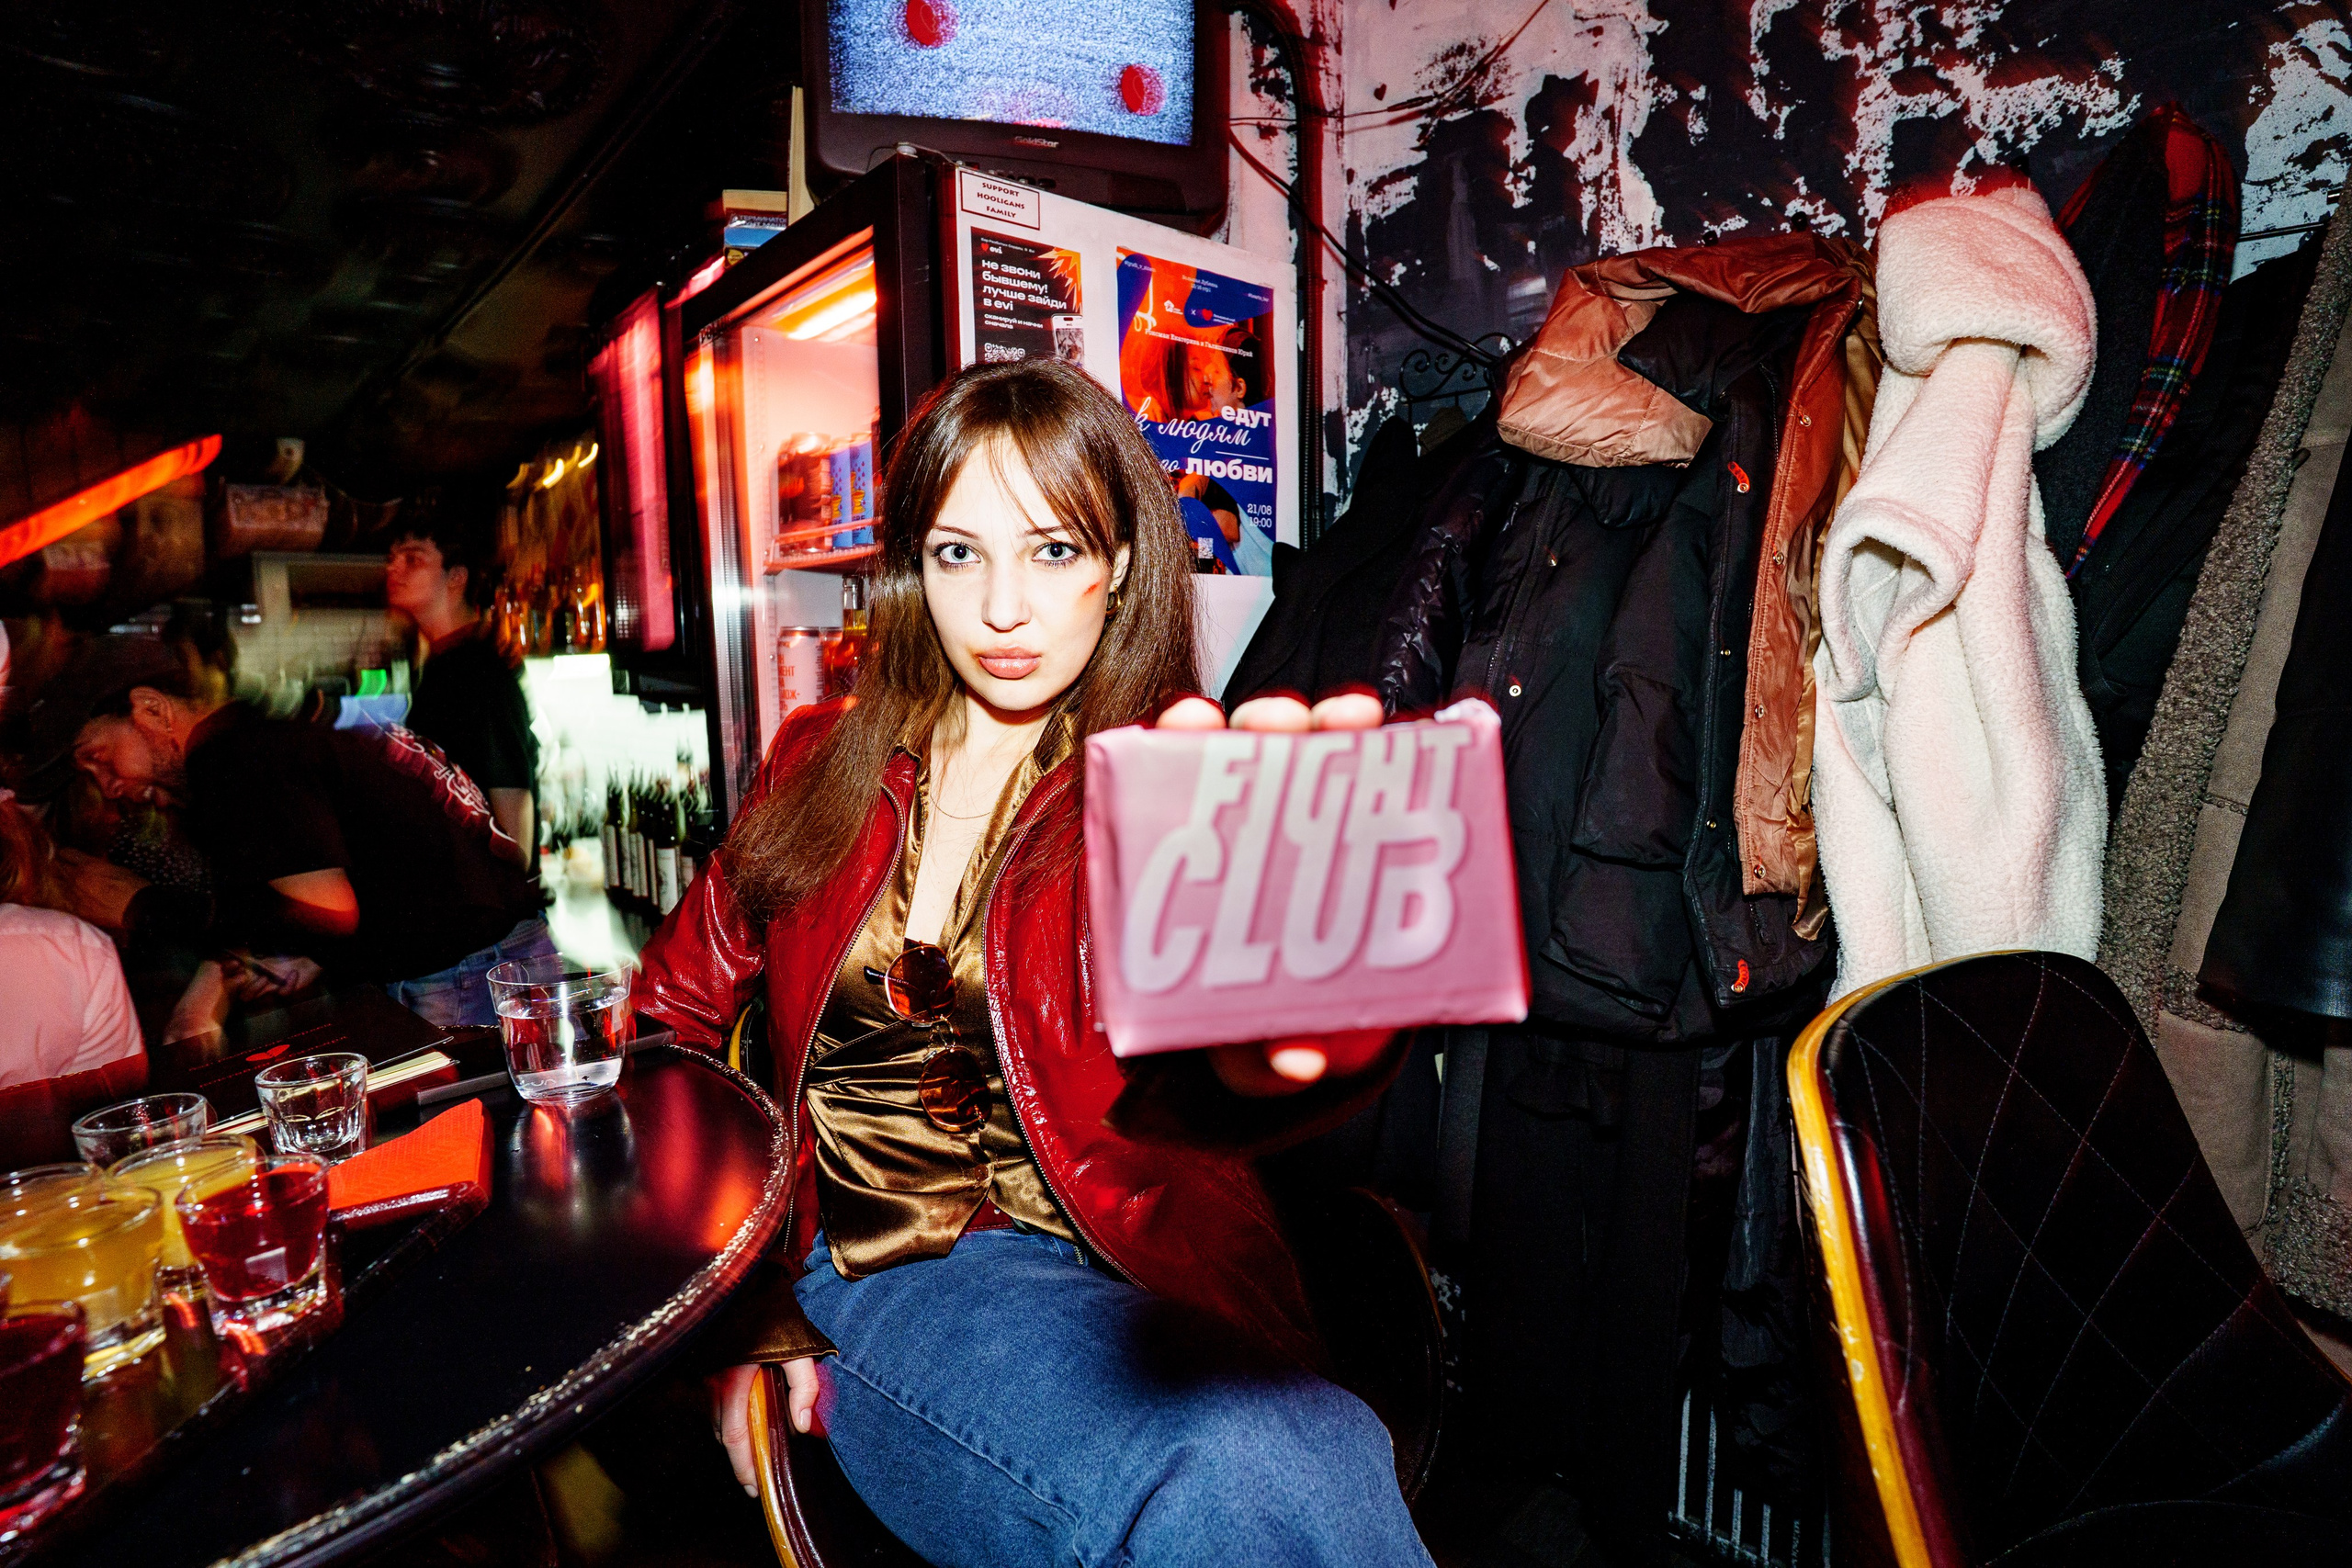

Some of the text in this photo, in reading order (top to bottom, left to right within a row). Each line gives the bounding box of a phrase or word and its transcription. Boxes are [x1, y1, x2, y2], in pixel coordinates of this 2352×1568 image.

[1014, 136, 1058, 148] GoldStar
[982, 182, 1019, 197] SUPPORT
[977, 192, 1024, 209] HOOLIGANS
[986, 206, 1016, 219] FAMILY
[989, 246, 1002, 254] evi
[981, 259, 1041, 279] не звони
[982, 270, 1048, 295] бывшему!
[982, 286, 1067, 310] лучше зайди
[983, 298, 1013, 310] в evi
[984, 313, 1017, 325] сканируй
[1220, 405, 1272, 430] едут
[1158, 418, 1251, 455] людям
[1185, 457, 1273, 484] любви
[1247, 502, 1272, 516] 21/08
[1248, 516, 1272, 528] 19:00
[1189, 724, 1472, 843] FIGHT
[1122, 808, 1467, 996] CLUB
